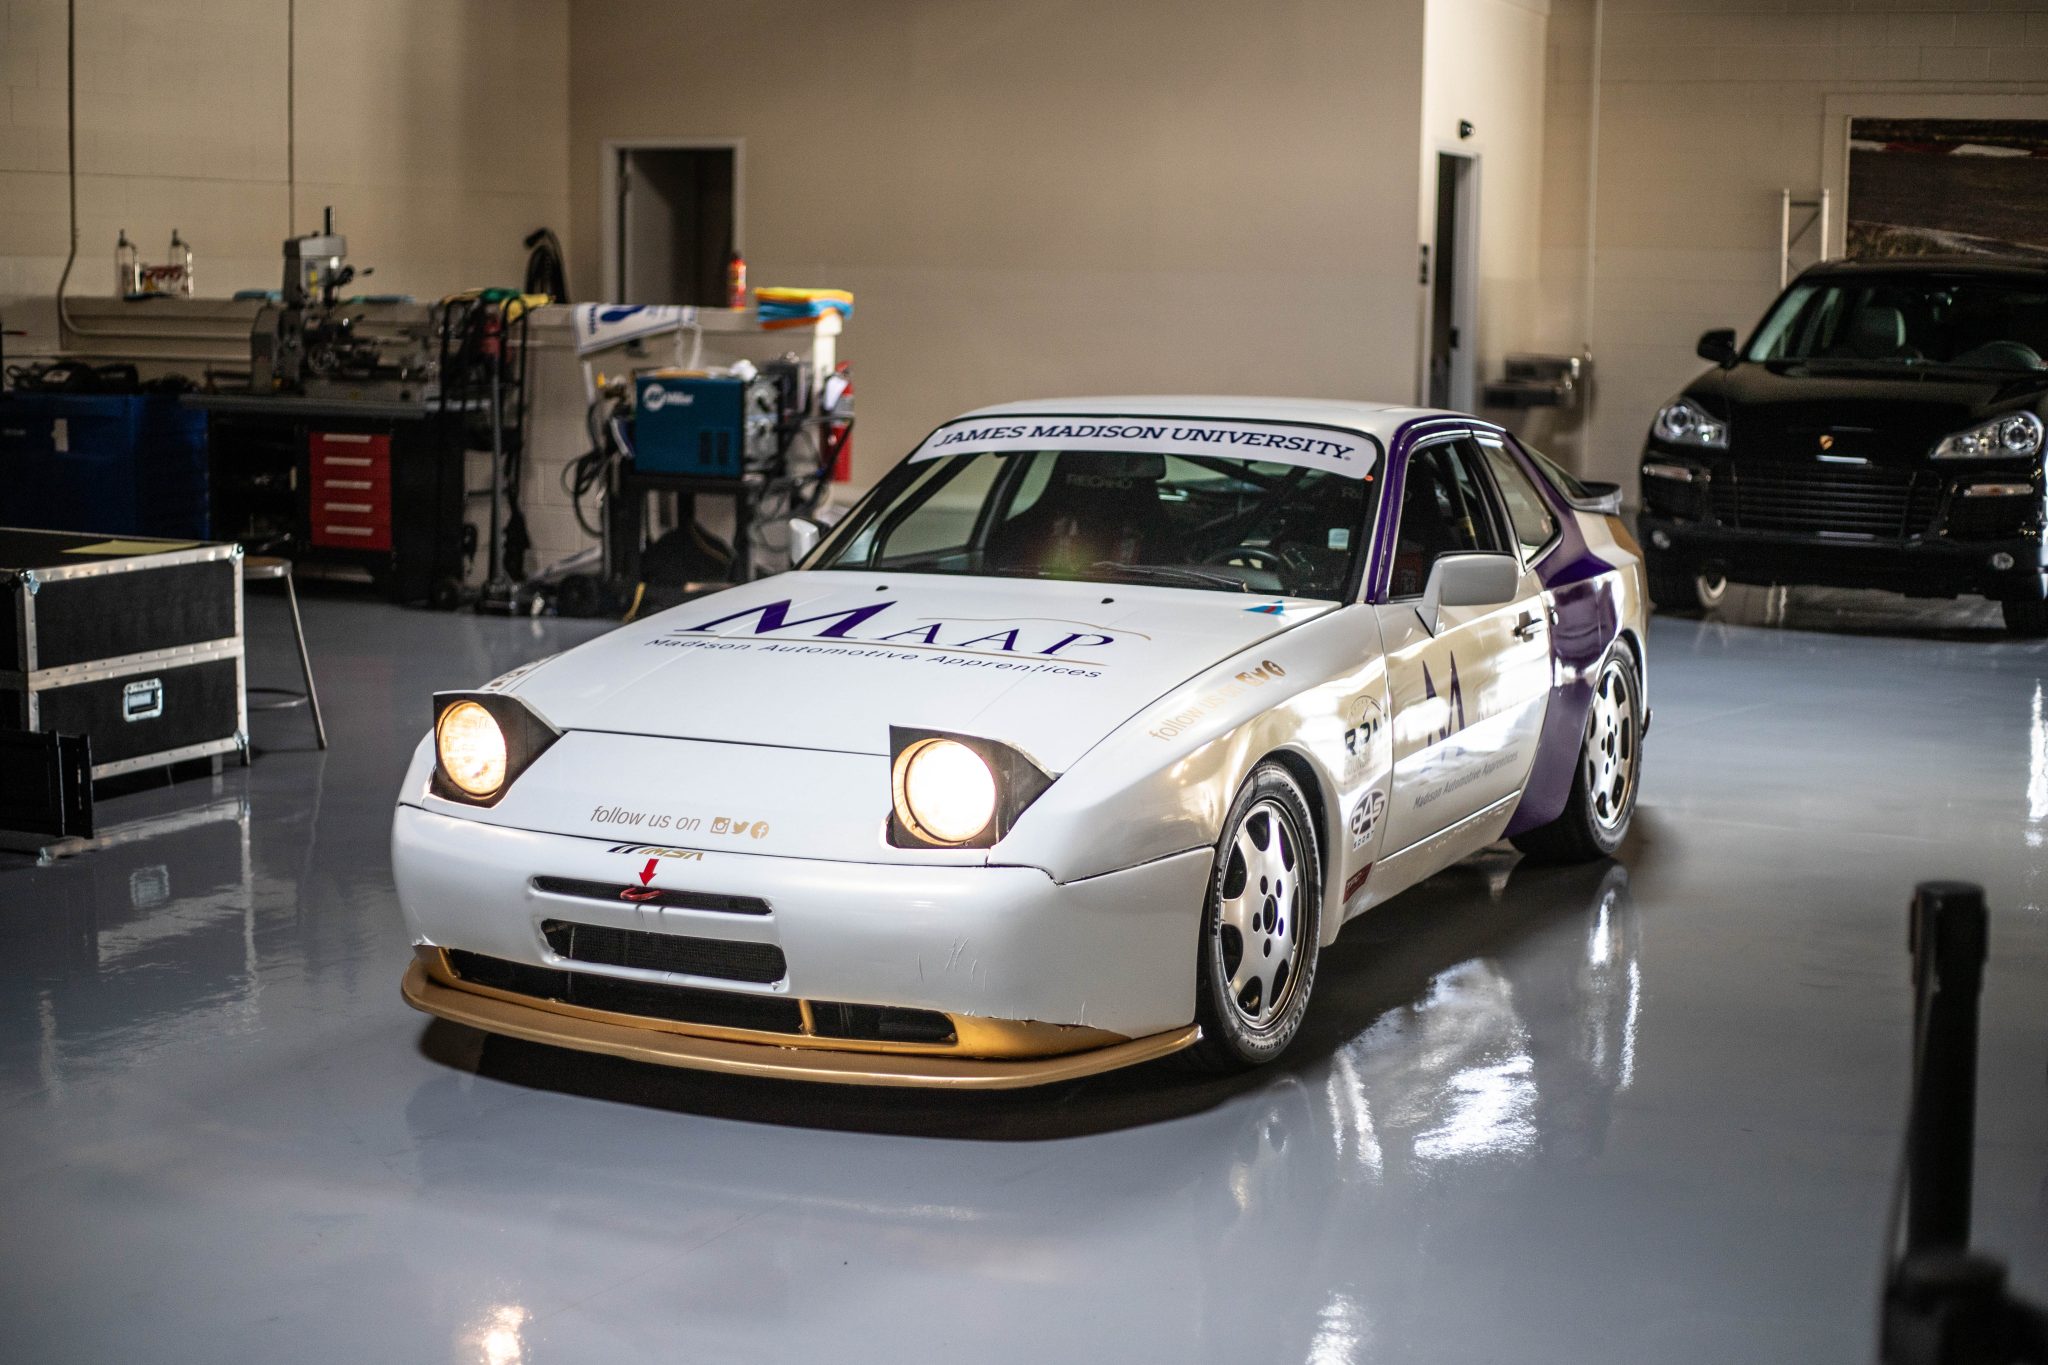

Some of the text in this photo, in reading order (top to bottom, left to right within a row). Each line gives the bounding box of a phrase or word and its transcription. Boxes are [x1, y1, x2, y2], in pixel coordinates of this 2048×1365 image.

[933, 426, 1027, 448] JAMES
[1027, 425, 1168, 439] MADISON
[674, 599, 1115, 656] MAAP
[644, 637, 1102, 678] Madison Automotive Apprentices
[1148, 706, 1206, 742] follow
[1412, 786, 1443, 809] Madison
[1443, 768, 1482, 795] Automotive
[590, 805, 701, 831] follow us on
